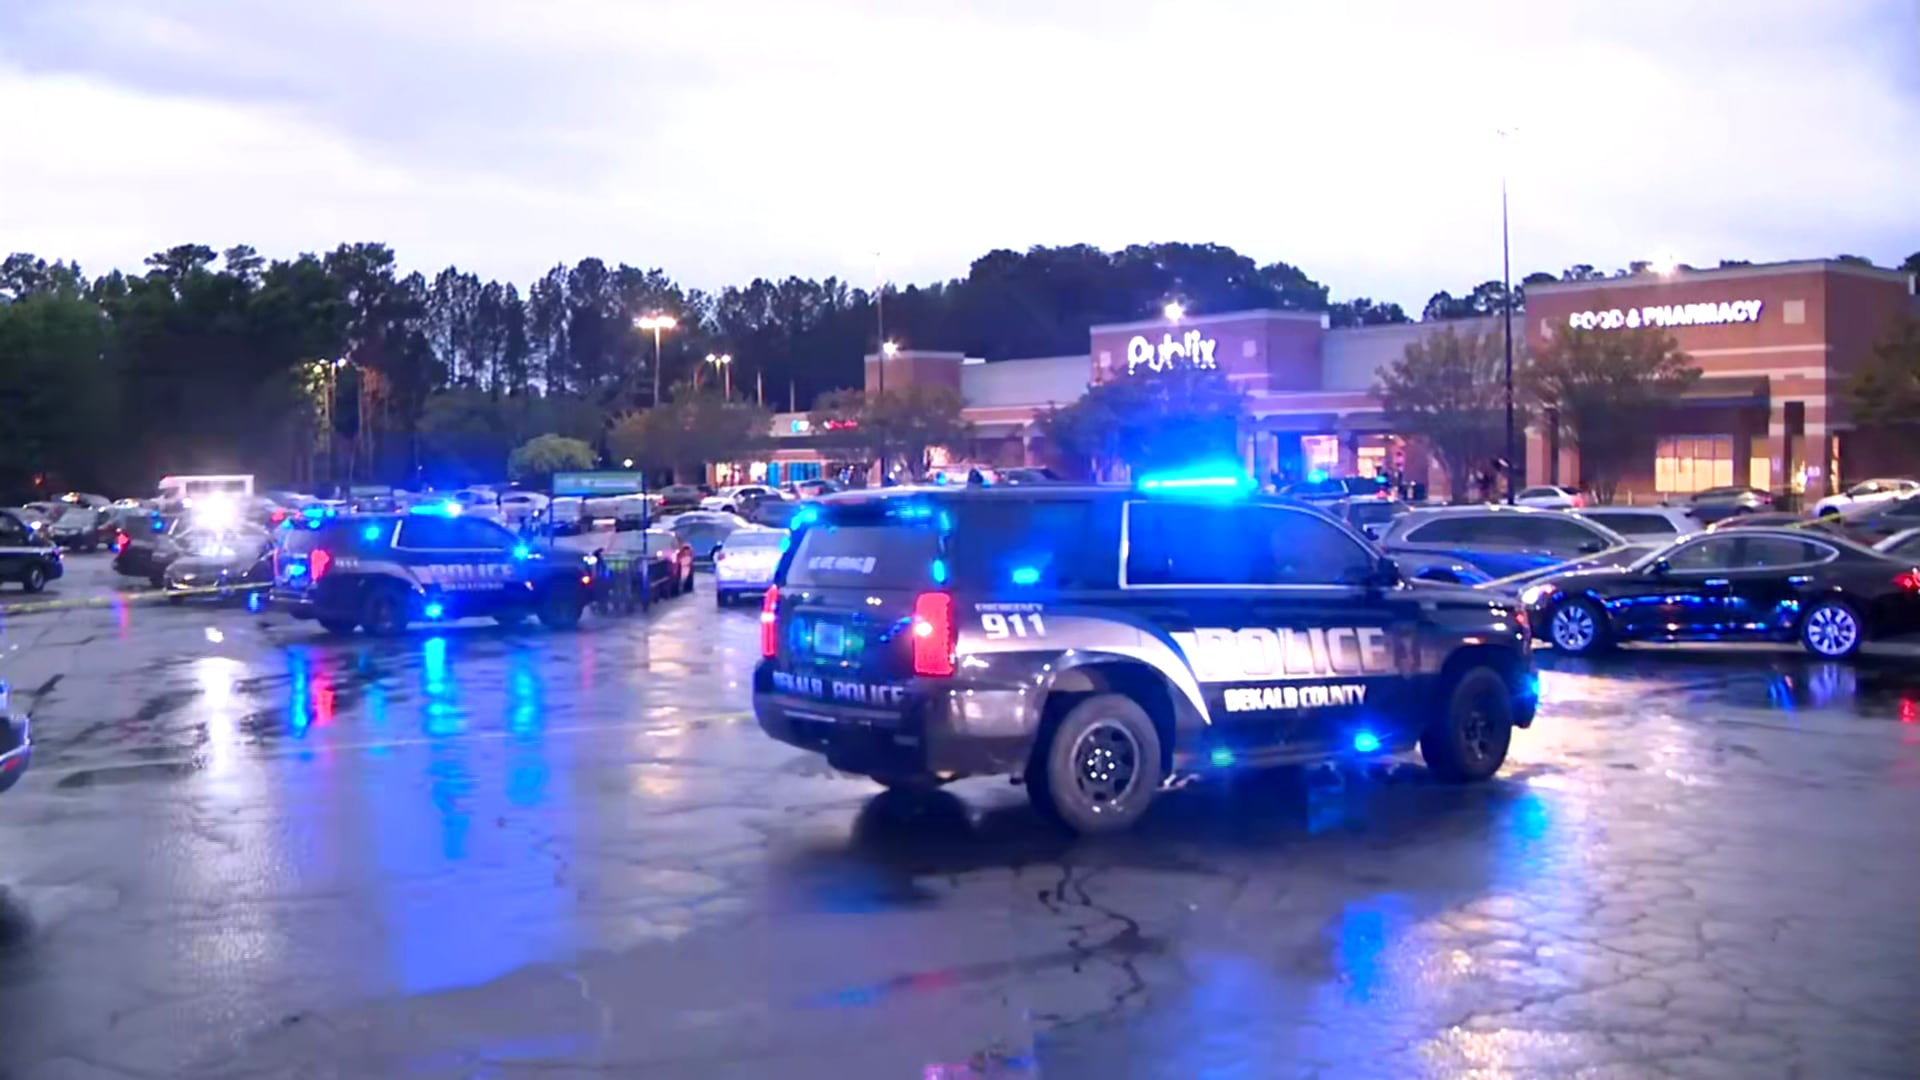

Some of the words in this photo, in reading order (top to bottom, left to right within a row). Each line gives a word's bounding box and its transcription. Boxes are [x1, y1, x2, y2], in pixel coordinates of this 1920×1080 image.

[1569, 310, 1624, 329] FOOD
[1626, 308, 1641, 328] &
[1642, 300, 1762, 327] PHARMACY
[1127, 329, 1217, 376] Publix
[981, 613, 1047, 639] 911
[1194, 627, 1391, 677] POLICE
[1223, 687, 1299, 712] DEKALB
[1299, 684, 1367, 707] COUNTY
